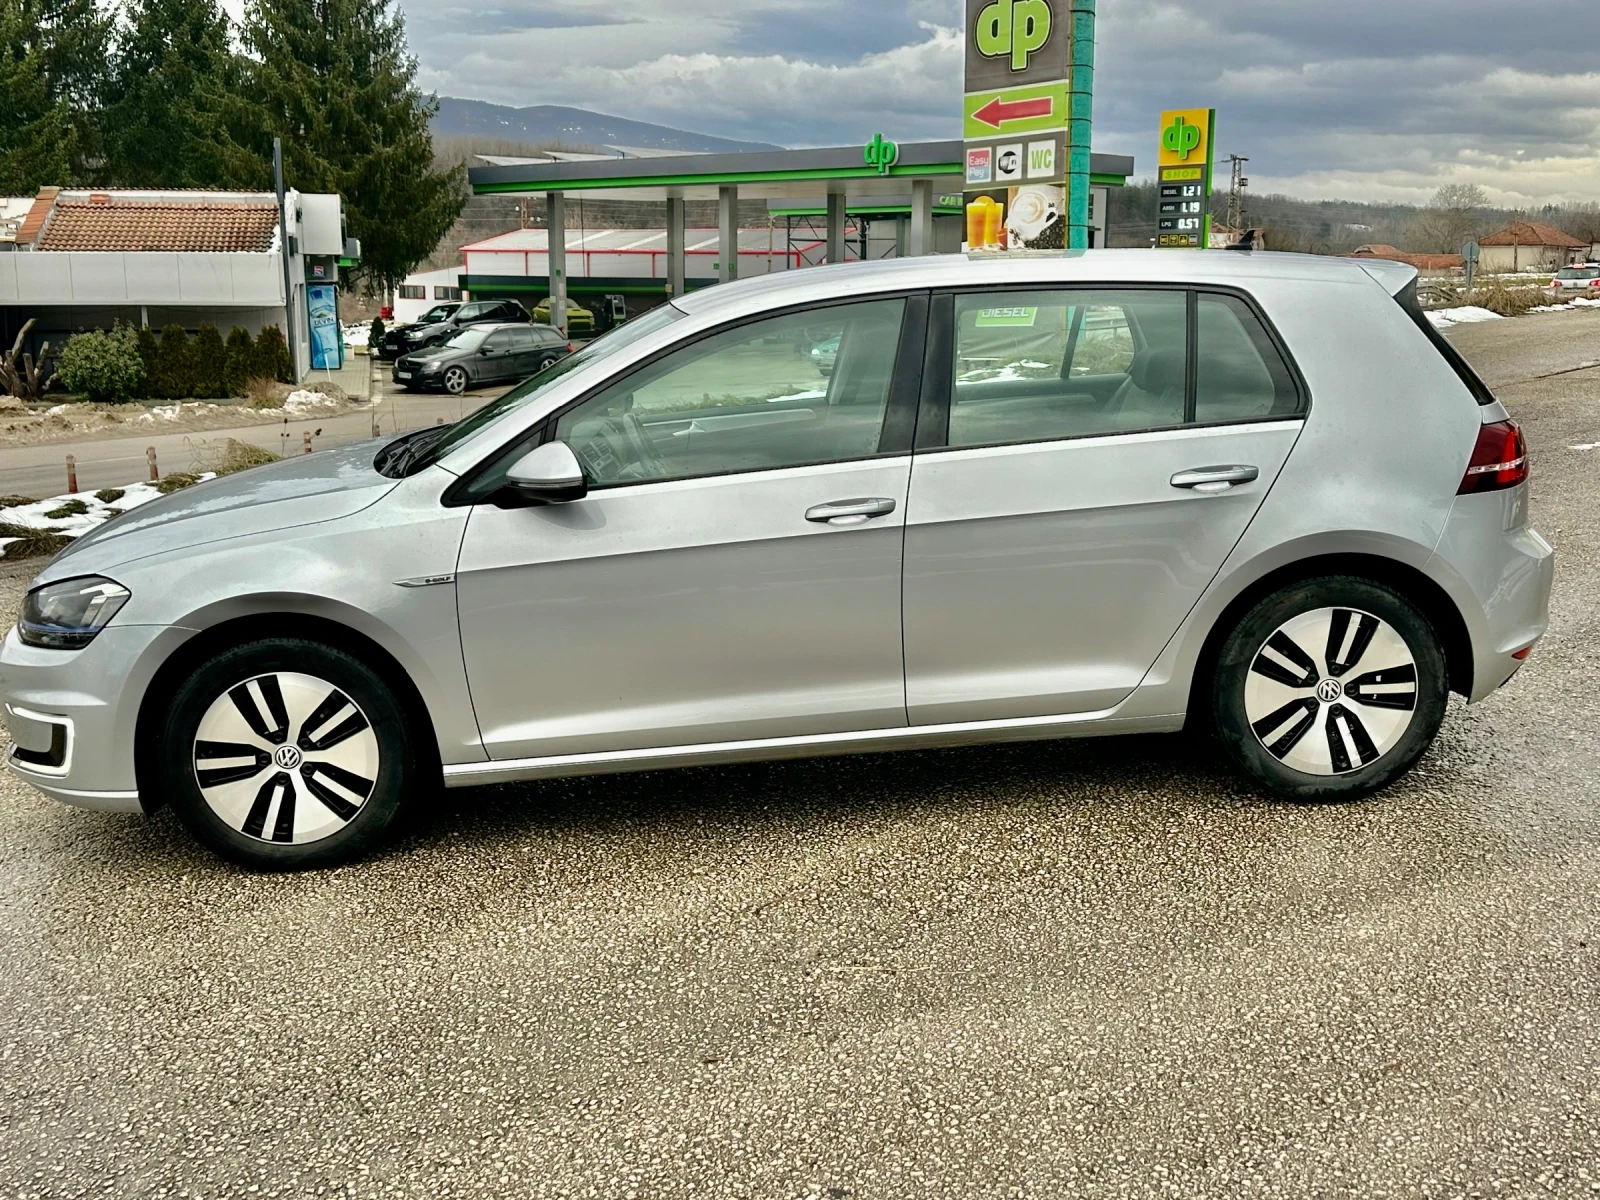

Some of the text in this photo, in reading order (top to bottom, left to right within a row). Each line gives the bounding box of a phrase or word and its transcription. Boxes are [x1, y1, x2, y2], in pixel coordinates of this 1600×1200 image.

[976, 0, 1051, 70] dp
[1163, 116, 1199, 159] dp
[864, 133, 896, 174] dp
[1031, 148, 1052, 169] WC
[969, 155, 989, 166] Easy
[969, 167, 985, 178] Pay
[1165, 170, 1198, 179] SHOP
[939, 196, 957, 206] CAR
[981, 307, 1029, 318] DIESEL
